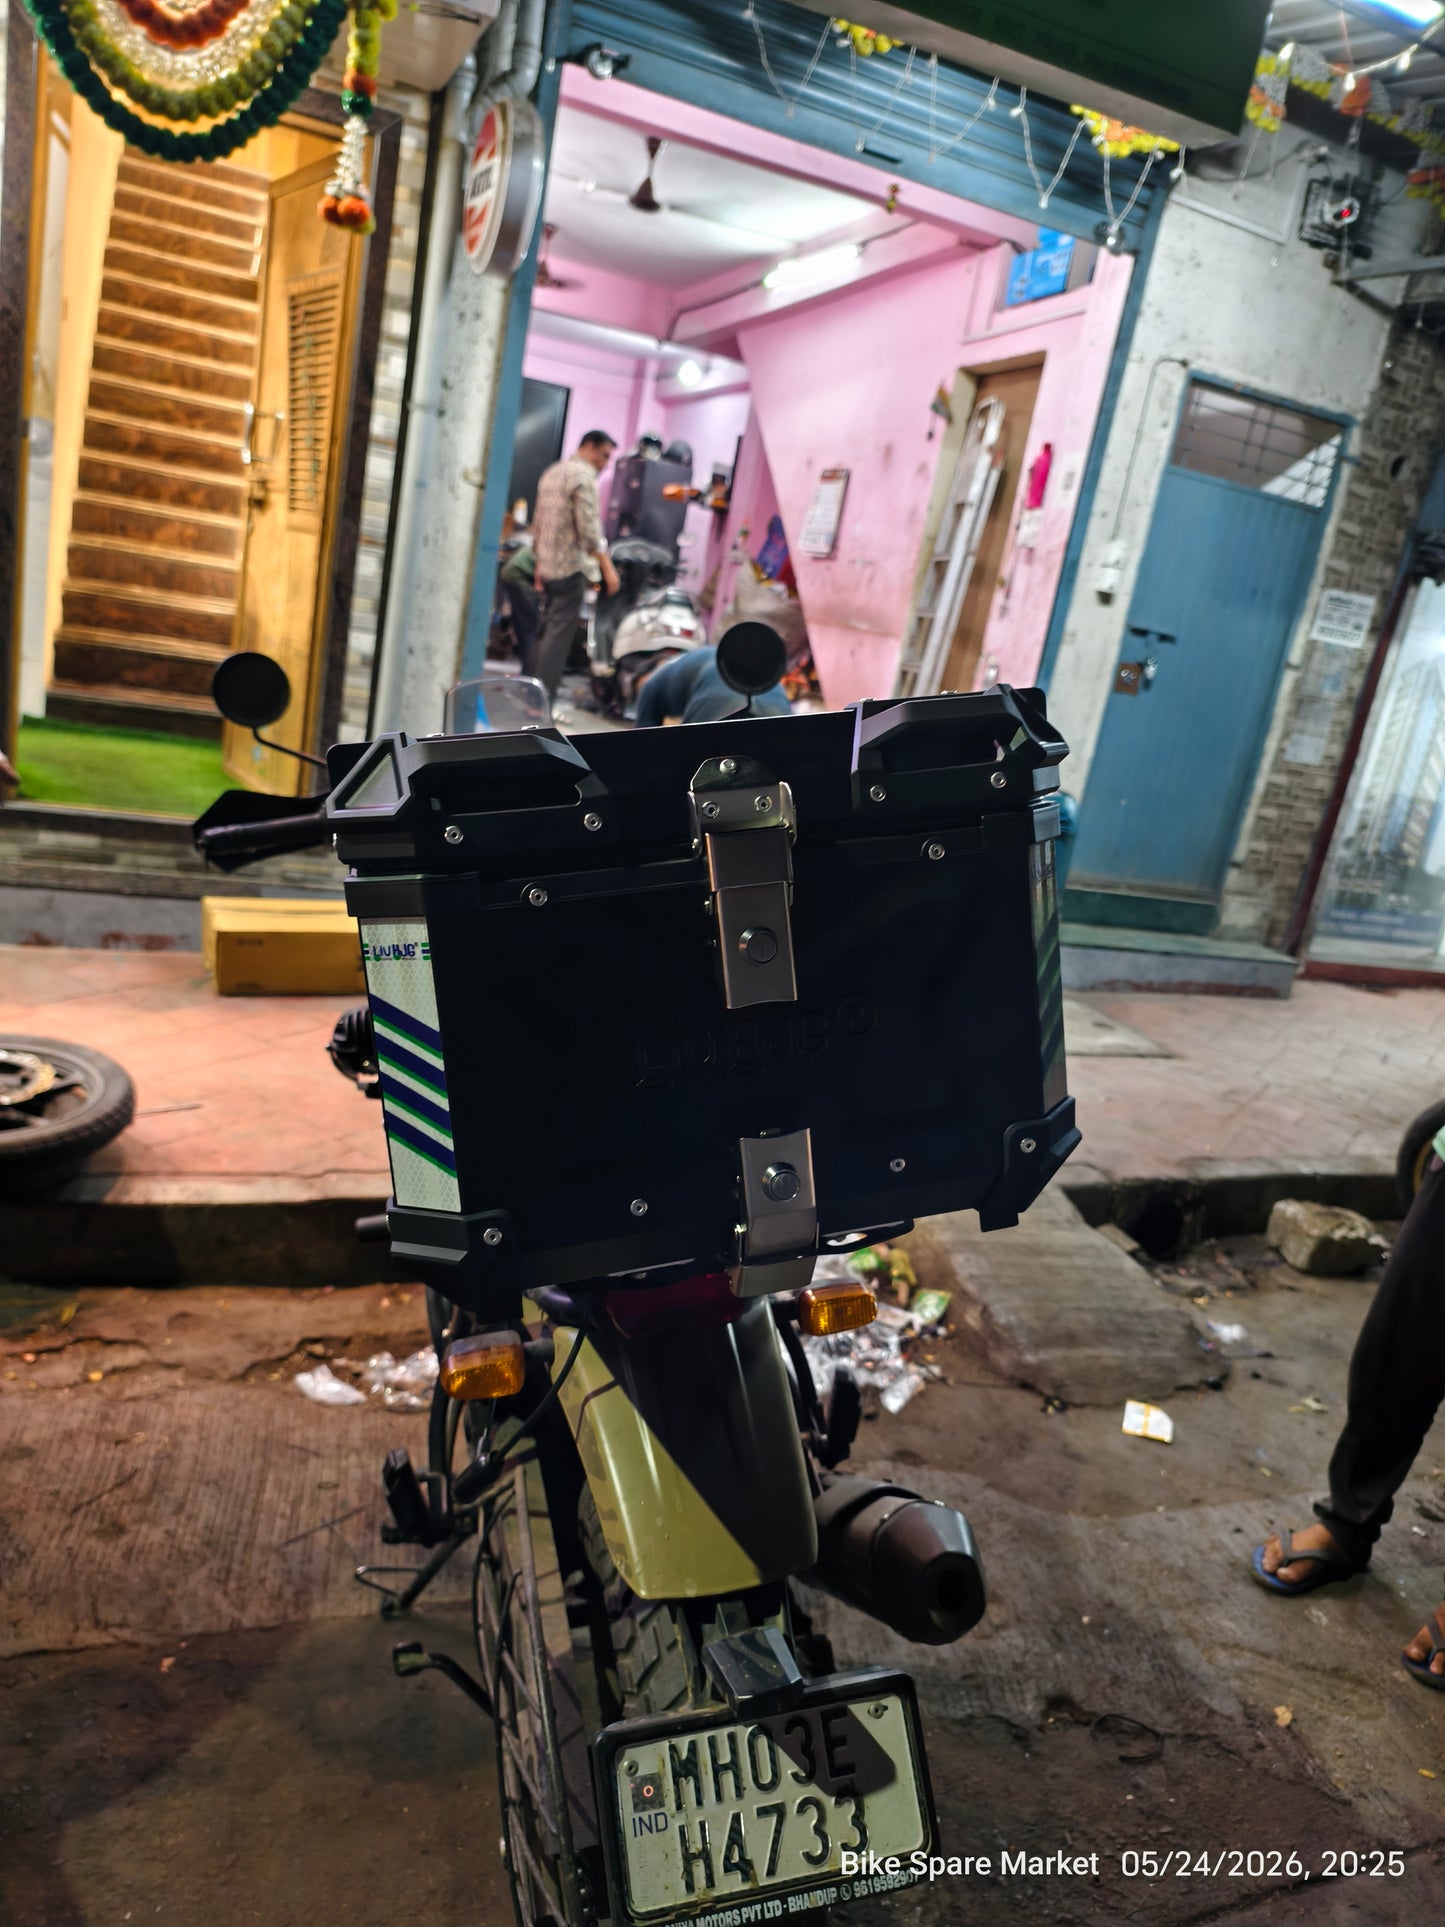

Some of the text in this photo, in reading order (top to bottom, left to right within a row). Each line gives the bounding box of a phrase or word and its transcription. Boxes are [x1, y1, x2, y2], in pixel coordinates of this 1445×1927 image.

[668, 1704, 857, 1811] MH03E
[632, 1811, 668, 1838] IND
[678, 1788, 870, 1895] H4733
[741, 1904, 762, 1923] PVT
[764, 1900, 783, 1920] LTD
[788, 1887, 838, 1912] BHANDUP
